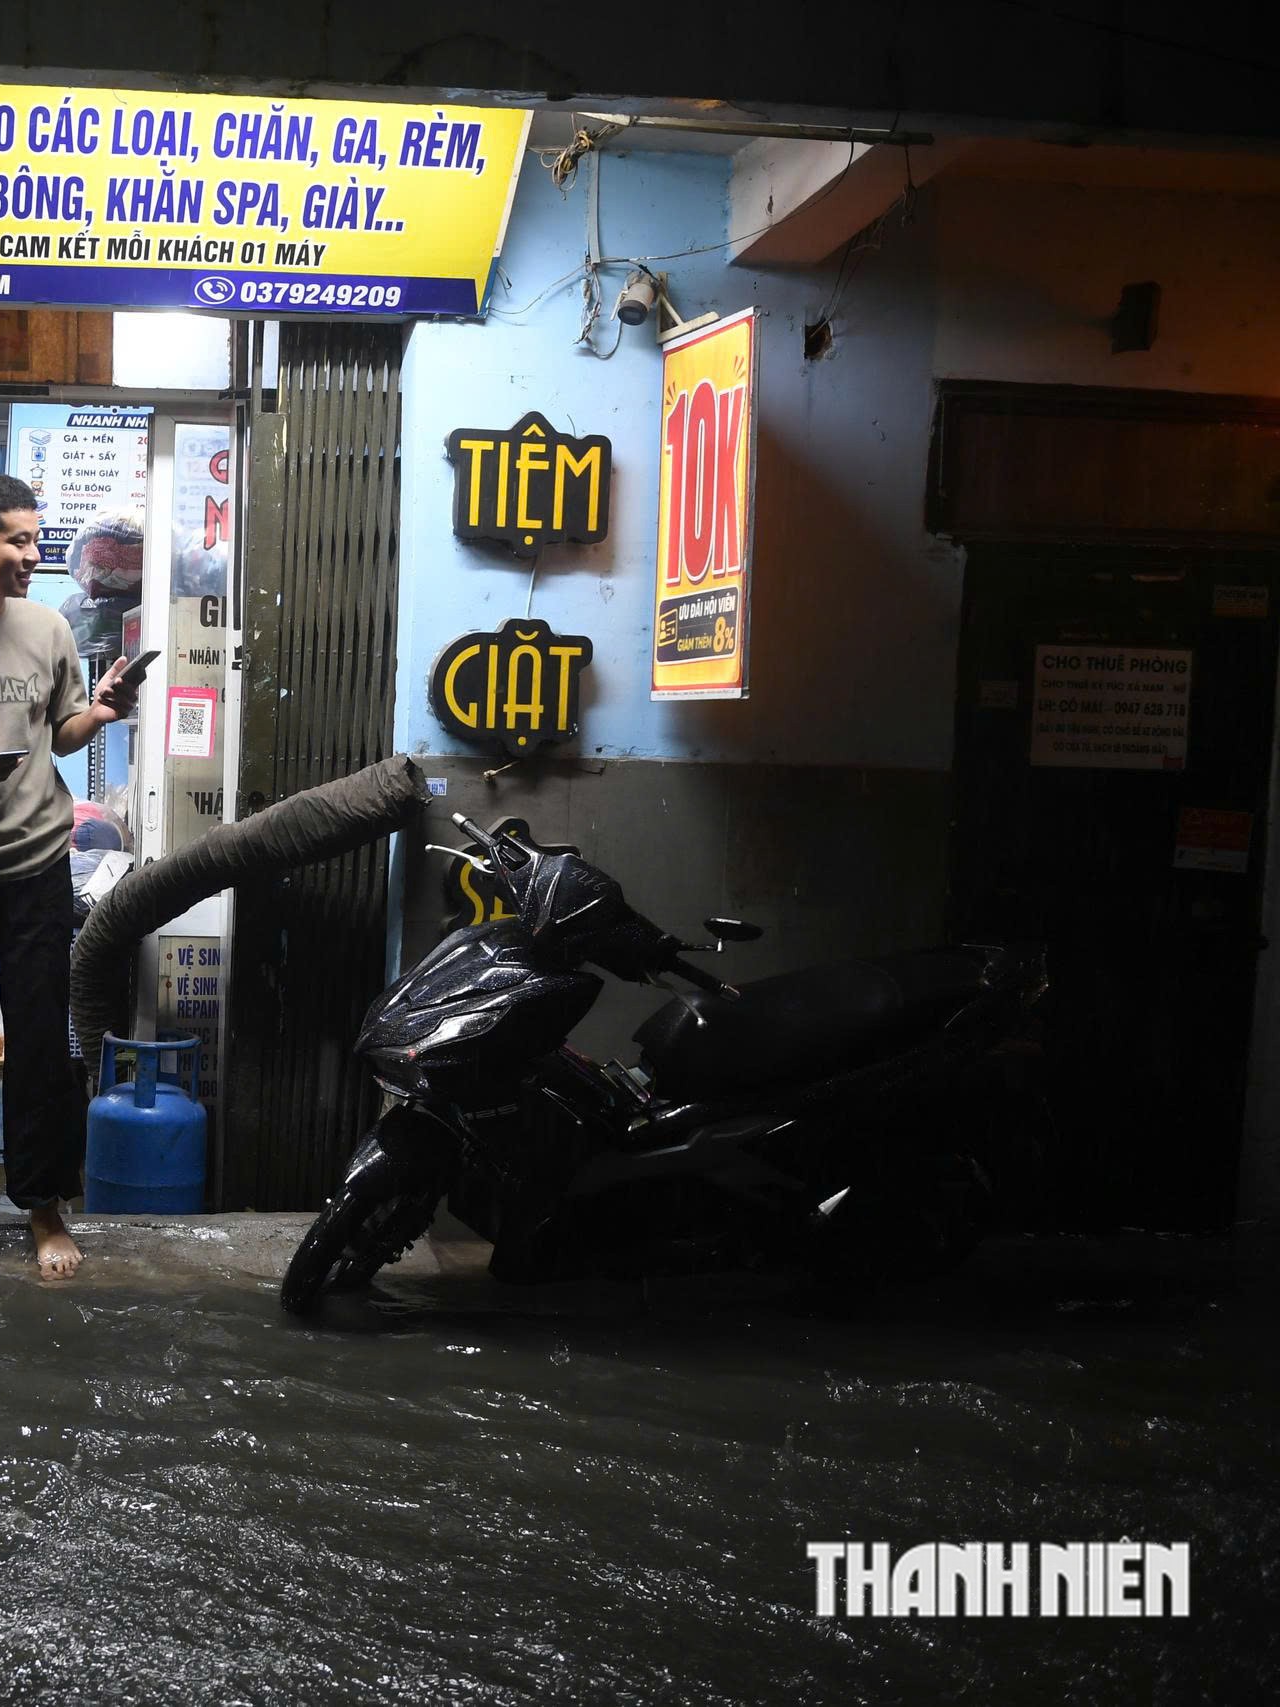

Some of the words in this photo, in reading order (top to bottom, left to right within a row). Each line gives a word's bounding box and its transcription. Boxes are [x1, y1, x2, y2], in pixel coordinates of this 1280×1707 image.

[27, 96, 99, 156] CÁC
[111, 108, 199, 168] LOẠI,
[212, 103, 319, 166] CHĂN,
[333, 118, 387, 172] GA,
[400, 111, 487, 175] RÈM,
[105, 164, 203, 225] KHĂN
[213, 178, 290, 234] SPA,
[302, 174, 405, 232] GIÀY...
[0, 235, 50, 258] CAM
[58, 228, 100, 260] KẾT
[107, 230, 151, 261] MỖI
[158, 235, 234, 263] KHÁCH
[241, 242, 266, 264] 01
[274, 237, 326, 267] MÁY
[240, 280, 401, 308] 0379249209
[71, 415, 123, 427] NHANH
[99, 451, 116, 460] SẤY
[62, 467, 72, 477] VỆ
[460, 423, 601, 545] TIỆM
[666, 378, 745, 584] 10K
[61, 482, 81, 491] GẤU
[84, 483, 111, 492] BÔNG
[679, 602, 690, 620] ƯU
[690, 598, 703, 618] ĐÃI
[705, 596, 717, 618] HỘI
[718, 592, 736, 613] VIÊN
[678, 633, 694, 651] GIẢM
[695, 632, 712, 650] THÊM
[713, 616, 734, 652] 8%
[190, 646, 219, 669] NHẬN
[1043, 655, 1081, 670] CHO
[1087, 653, 1124, 672] THUÊ
[1130, 656, 1188, 674] PHÒNG
[444, 630, 582, 747] GIẶT
[178, 944, 194, 970] VỆ
[177, 973, 189, 999] VỆ
[193, 977, 217, 996] SINH
